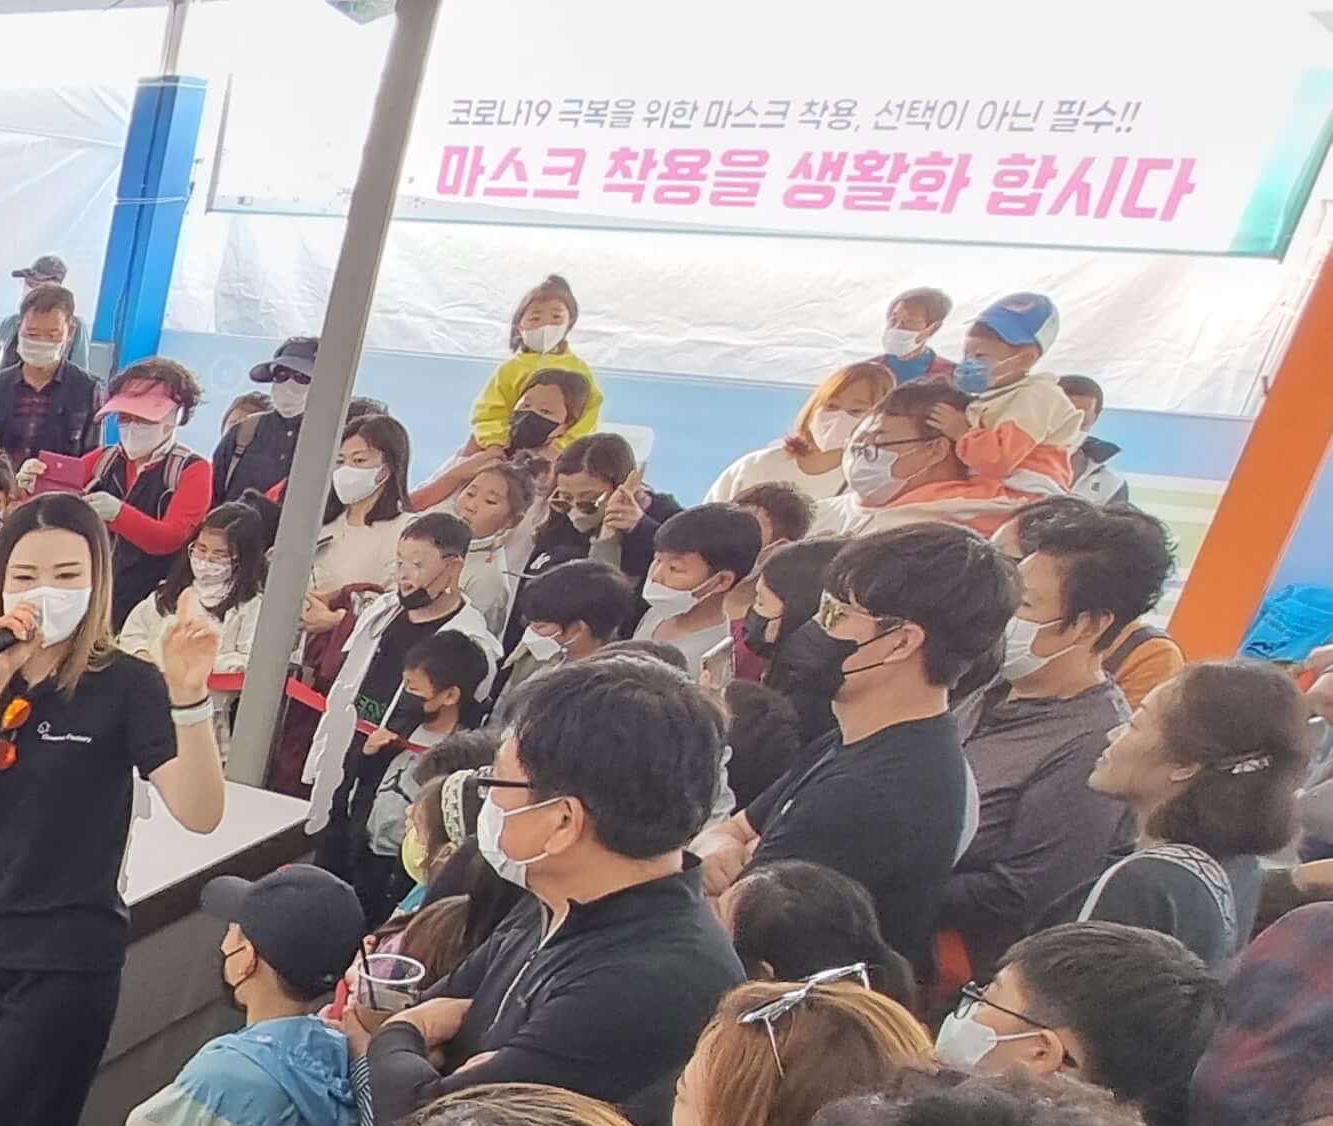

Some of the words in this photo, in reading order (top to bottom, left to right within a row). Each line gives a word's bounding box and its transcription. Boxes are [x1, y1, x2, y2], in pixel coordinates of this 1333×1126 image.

[448, 99, 552, 127] 코로나19
[558, 99, 636, 128] 극복을
[642, 99, 699, 129] 위한
[703, 99, 791, 129] 마스크
[799, 98, 860, 133] 착용,
[872, 98, 969, 132] 선택이
[976, 99, 1042, 133] 아닌
[1049, 100, 1142, 134] 필수!!
[436, 145, 587, 200] 마스크
[602, 146, 771, 207] 착용을
[782, 150, 973, 214] 생활화
[985, 153, 1197, 222] 합시다
